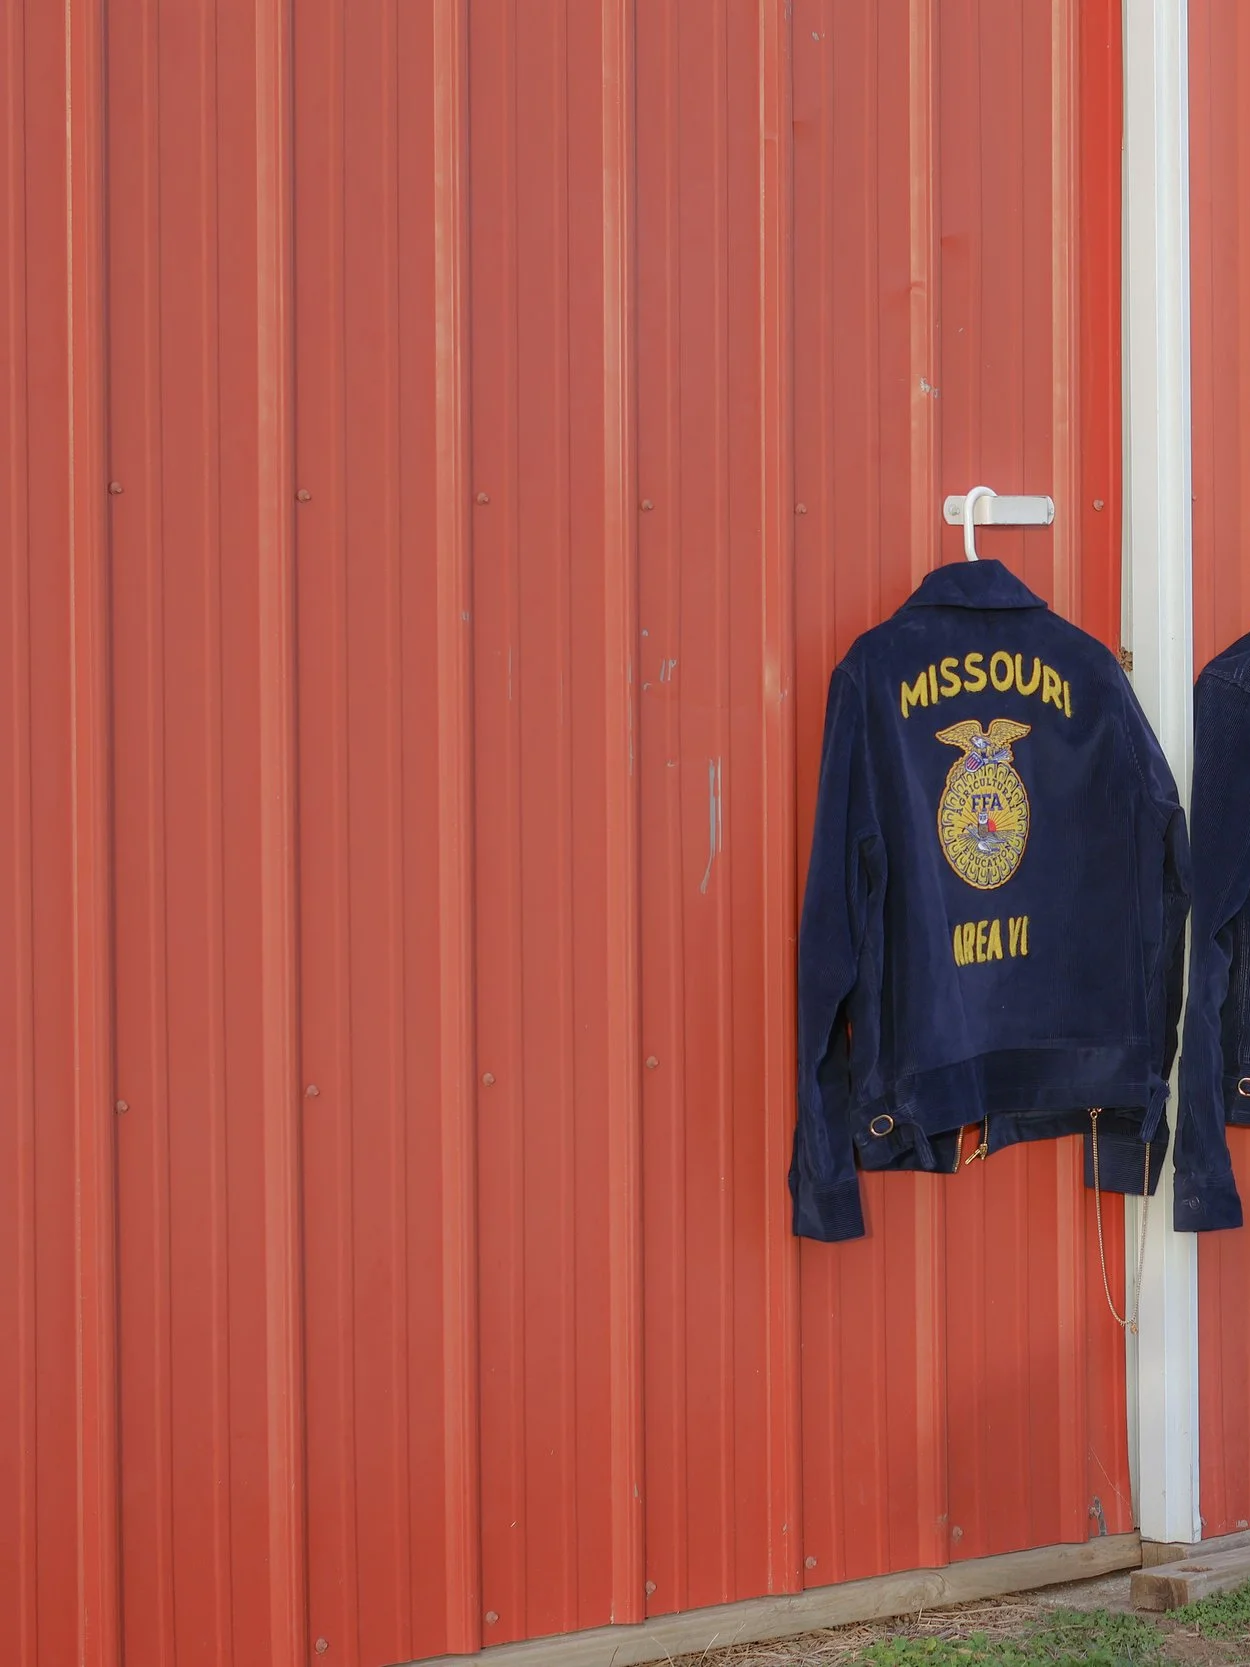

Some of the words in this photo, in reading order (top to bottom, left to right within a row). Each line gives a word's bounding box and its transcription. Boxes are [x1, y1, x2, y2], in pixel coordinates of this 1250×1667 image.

[901, 650, 1073, 719] MISSOURI
[955, 777, 1015, 816] AGRICULTURAL
[971, 792, 1004, 813] FFA
[963, 841, 1013, 868] EDUCATION
[953, 918, 1004, 967] AREA
